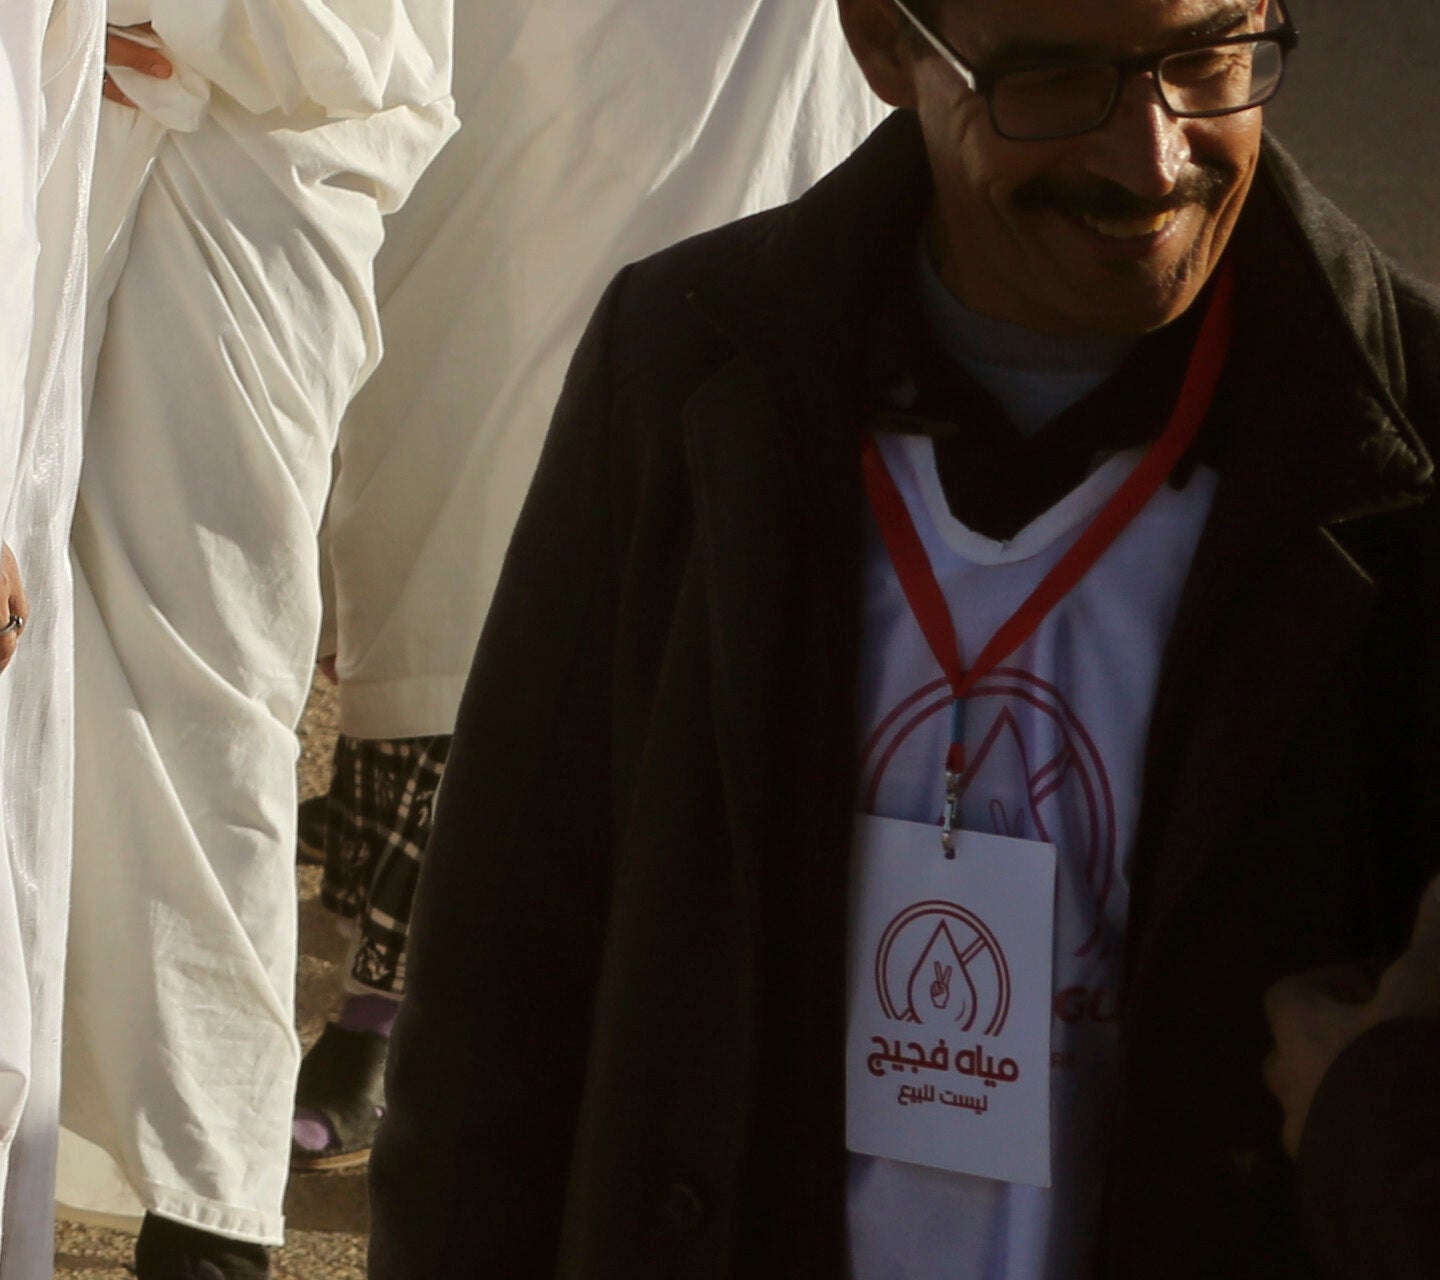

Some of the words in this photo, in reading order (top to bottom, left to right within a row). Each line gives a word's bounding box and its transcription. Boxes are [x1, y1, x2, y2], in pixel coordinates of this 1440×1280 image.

[867, 1035, 949, 1078] فجيج
[955, 1044, 1020, 1088] مياه
[897, 1083, 935, 1106] للبيع
[939, 1090, 988, 1116] ليست
